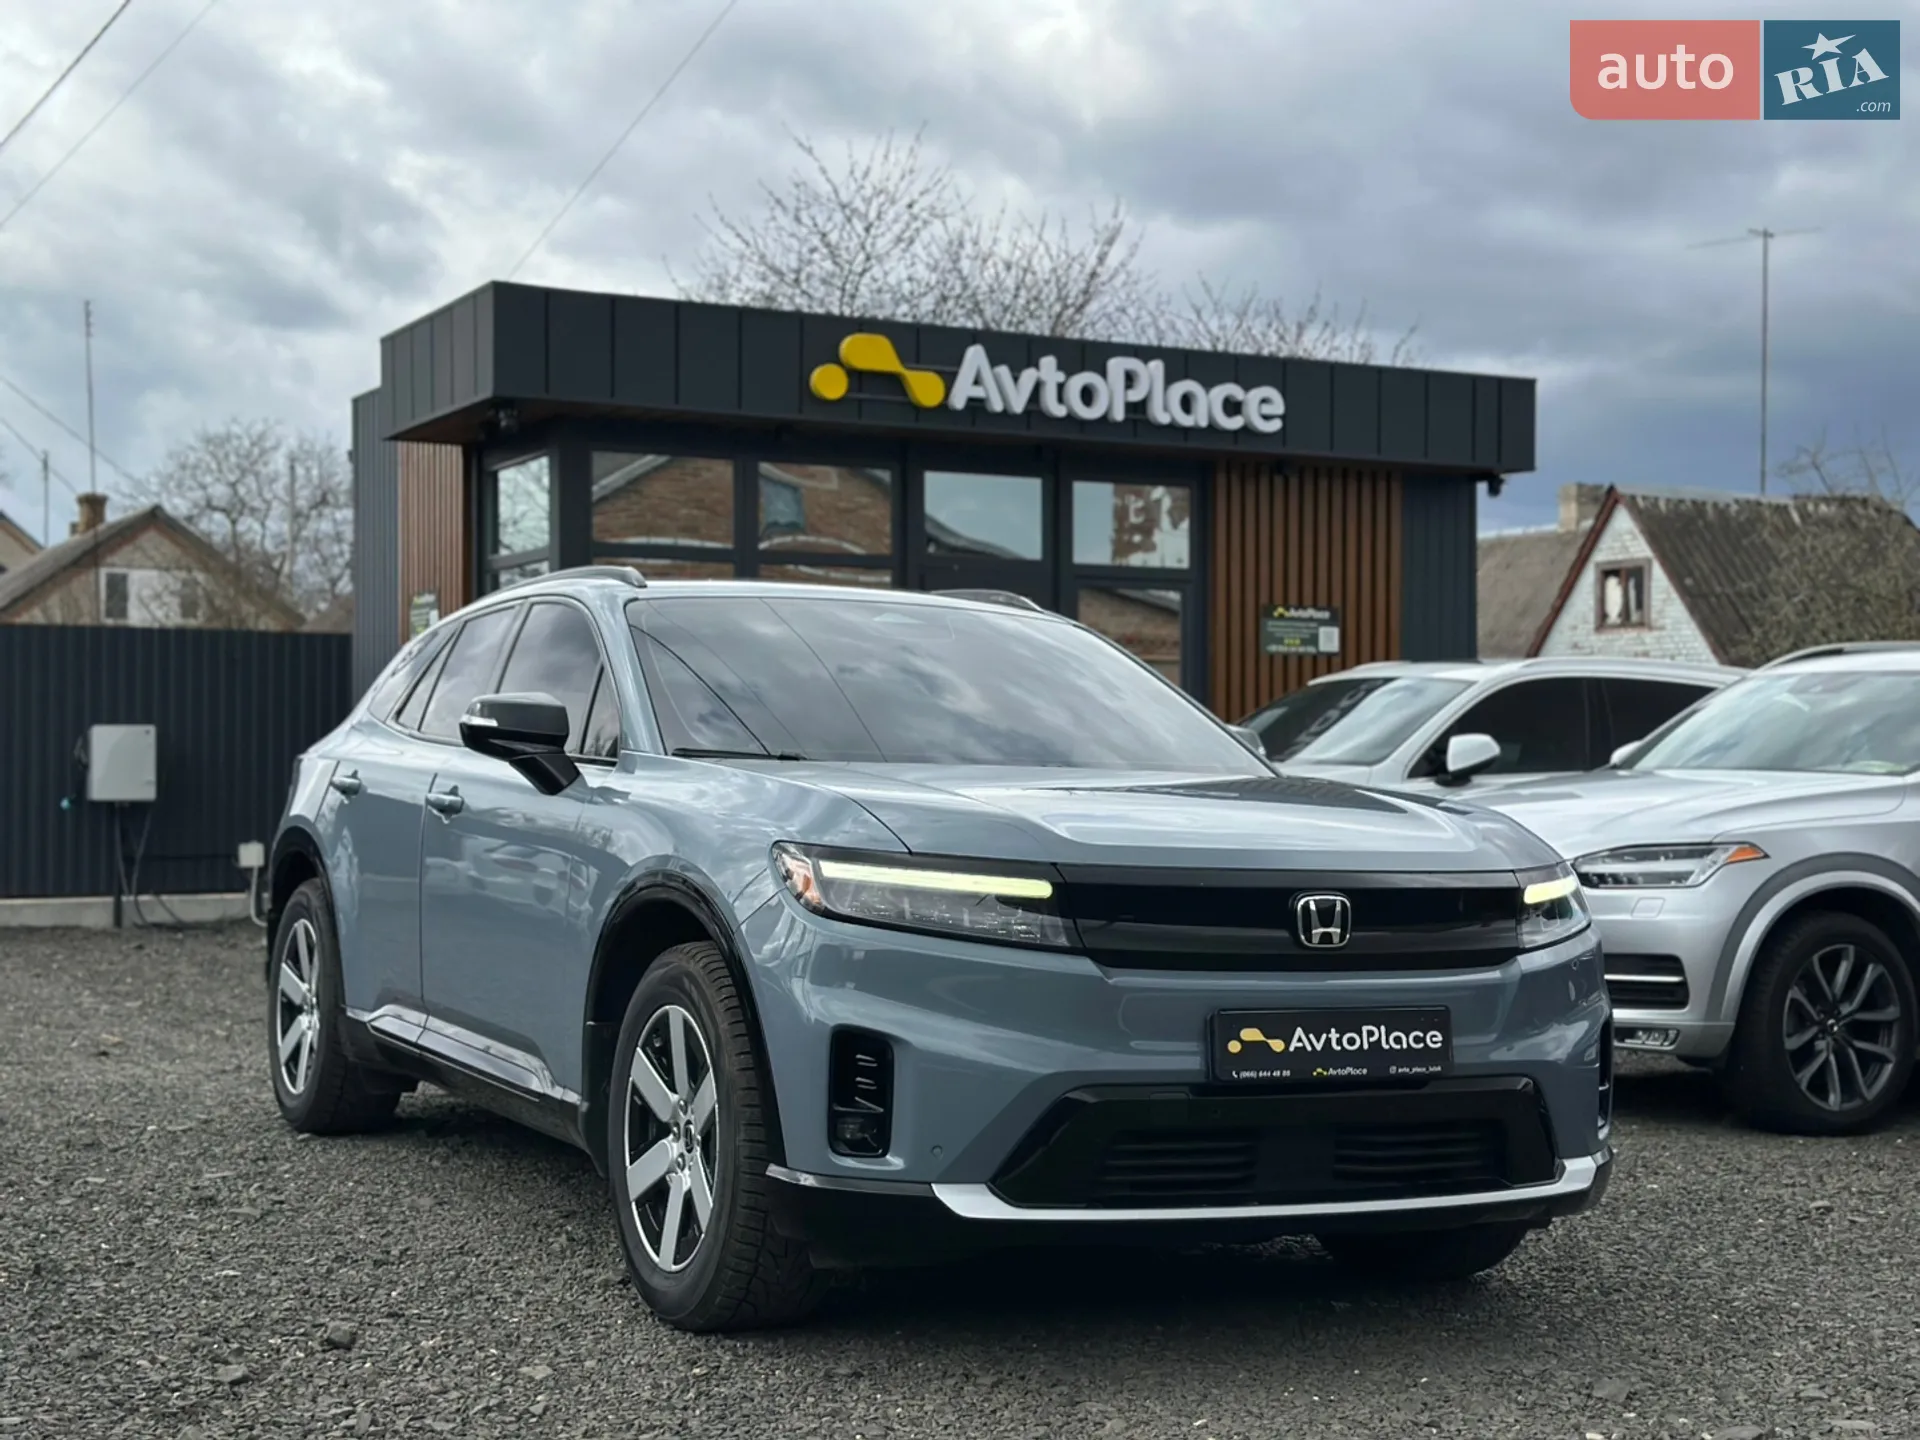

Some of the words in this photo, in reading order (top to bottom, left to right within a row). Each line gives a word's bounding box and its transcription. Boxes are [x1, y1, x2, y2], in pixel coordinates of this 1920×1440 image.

[948, 342, 1286, 434] AvtoPlace
[1288, 1025, 1444, 1053] AvtoPlace
[1328, 1066, 1368, 1076] AvtoPlace
